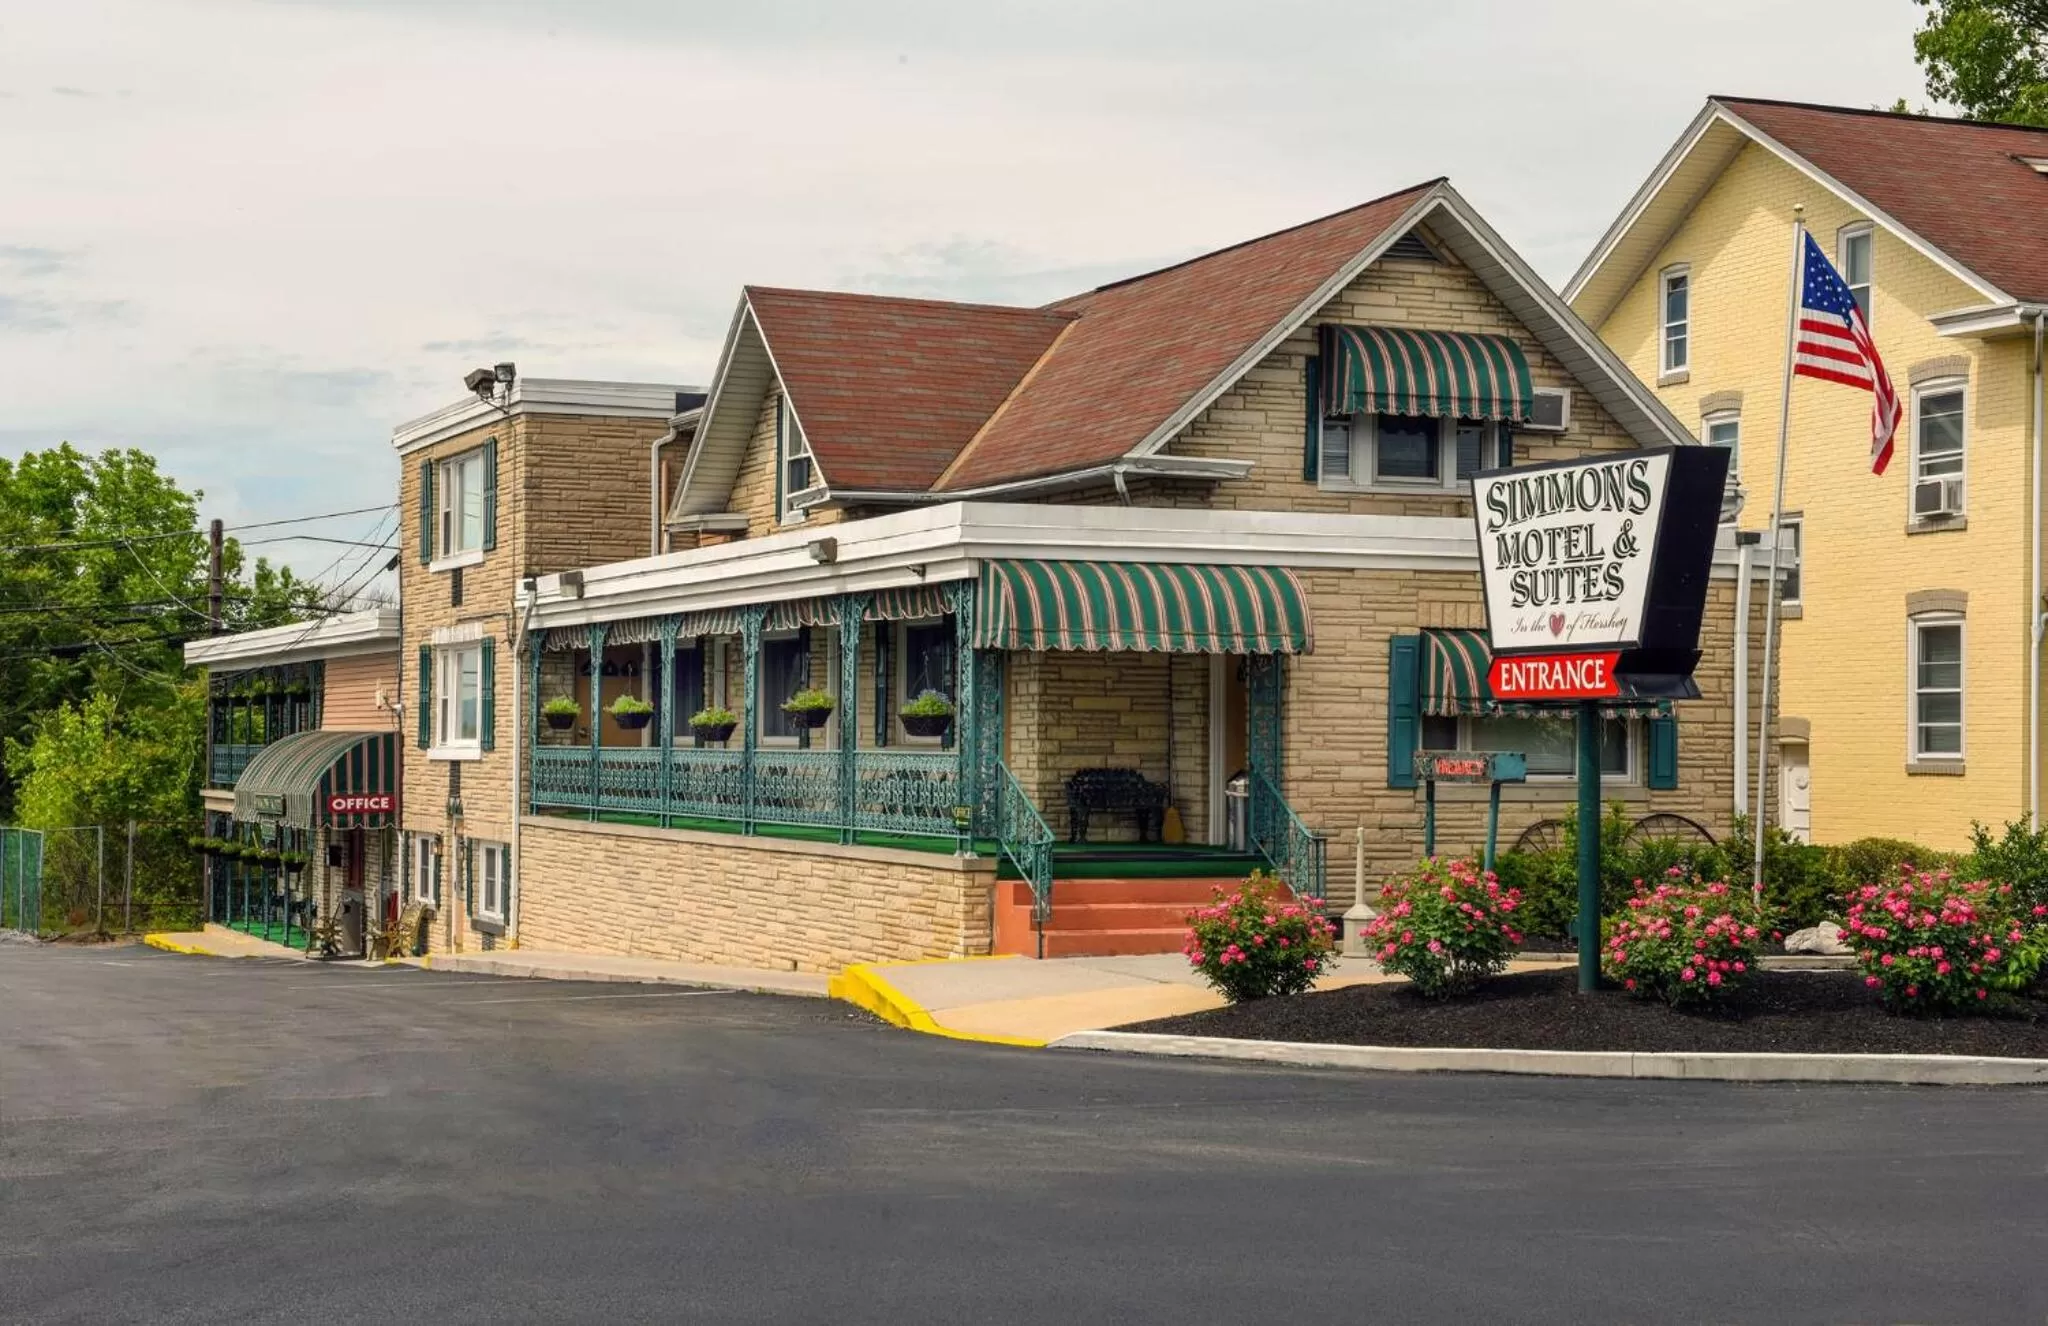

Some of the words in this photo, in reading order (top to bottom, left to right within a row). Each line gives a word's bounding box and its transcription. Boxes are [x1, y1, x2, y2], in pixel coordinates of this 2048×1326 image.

[1486, 460, 1651, 533] SIMMONS
[1496, 523, 1605, 570] MOTEL
[1613, 518, 1640, 559] &
[1510, 562, 1625, 607] SUITES
[1510, 616, 1528, 634] In
[1530, 611, 1546, 633] the
[1566, 611, 1583, 642] of
[1579, 606, 1628, 642] Hershey
[1501, 659, 1606, 691] ENTRANCE
[332, 797, 389, 810] OFFICE
